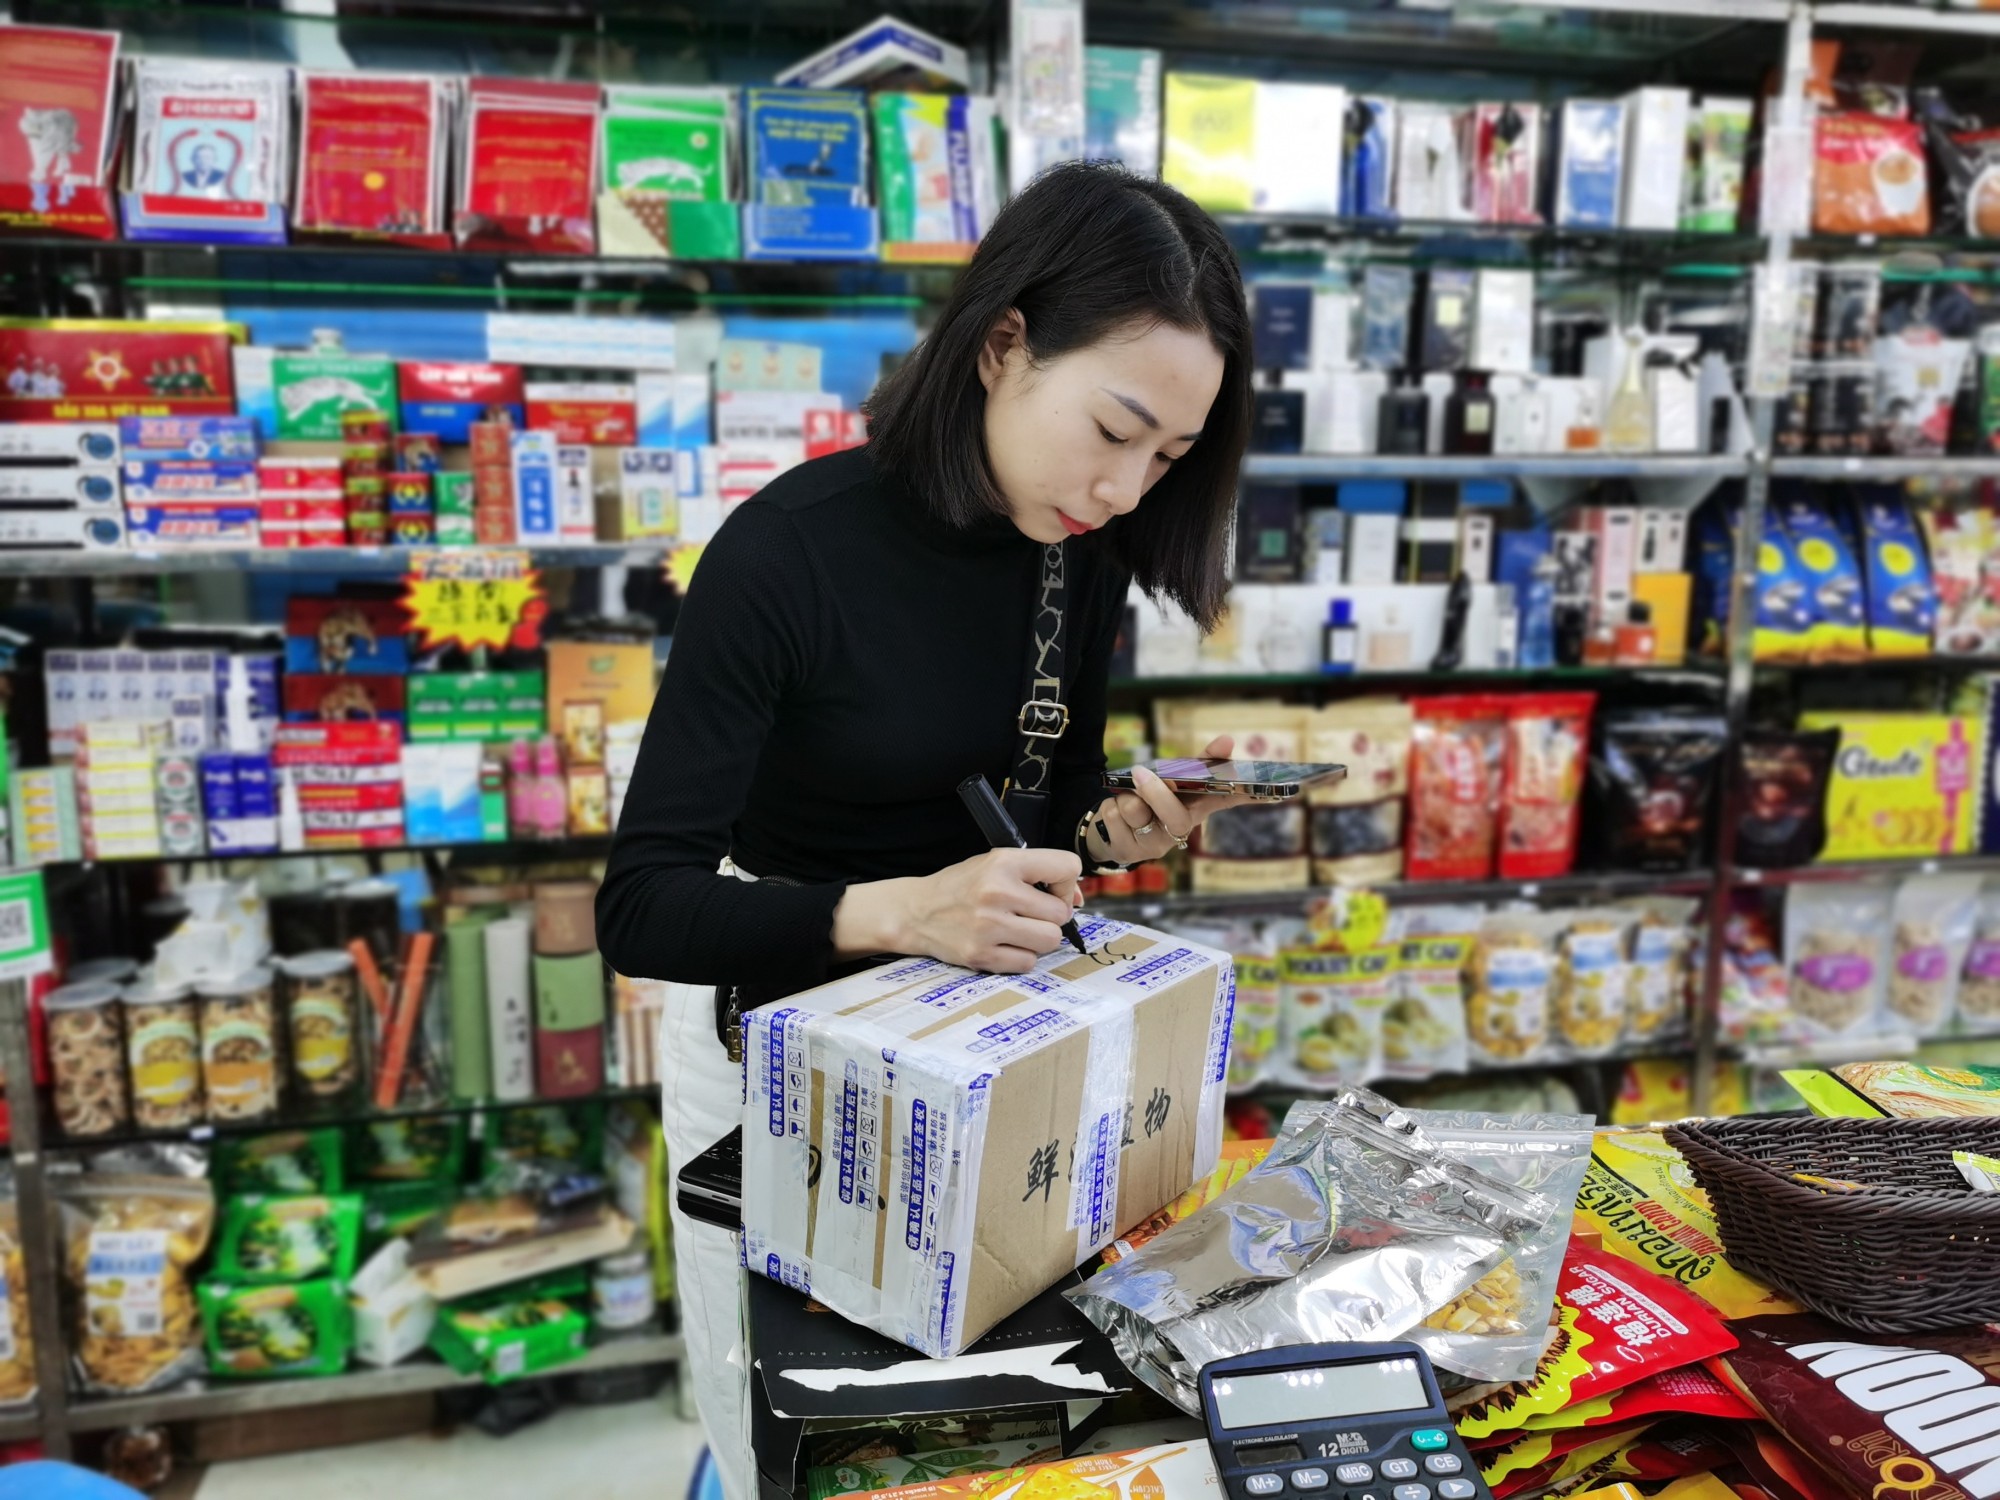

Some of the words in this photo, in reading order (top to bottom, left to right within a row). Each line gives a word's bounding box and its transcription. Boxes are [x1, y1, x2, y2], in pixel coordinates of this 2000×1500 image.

[1632, 1199, 1682, 1231] CANDY
[1569, 1265, 1616, 1295] SUGAR
[1616, 1297, 1672, 1338] DURIAN
[1233, 1436, 1264, 1446] ELECTRONIC
[1264, 1433, 1299, 1443] CALCULATOR
[1336, 1432, 1363, 1444] M&G
[1318, 1443, 1339, 1458] 12
[1340, 1445, 1370, 1456] DIGITS
[1389, 1460, 1410, 1474] GT
[1434, 1456, 1456, 1469] CE
[1341, 1465, 1370, 1480] MRC
[1251, 1477, 1276, 1491] M+
